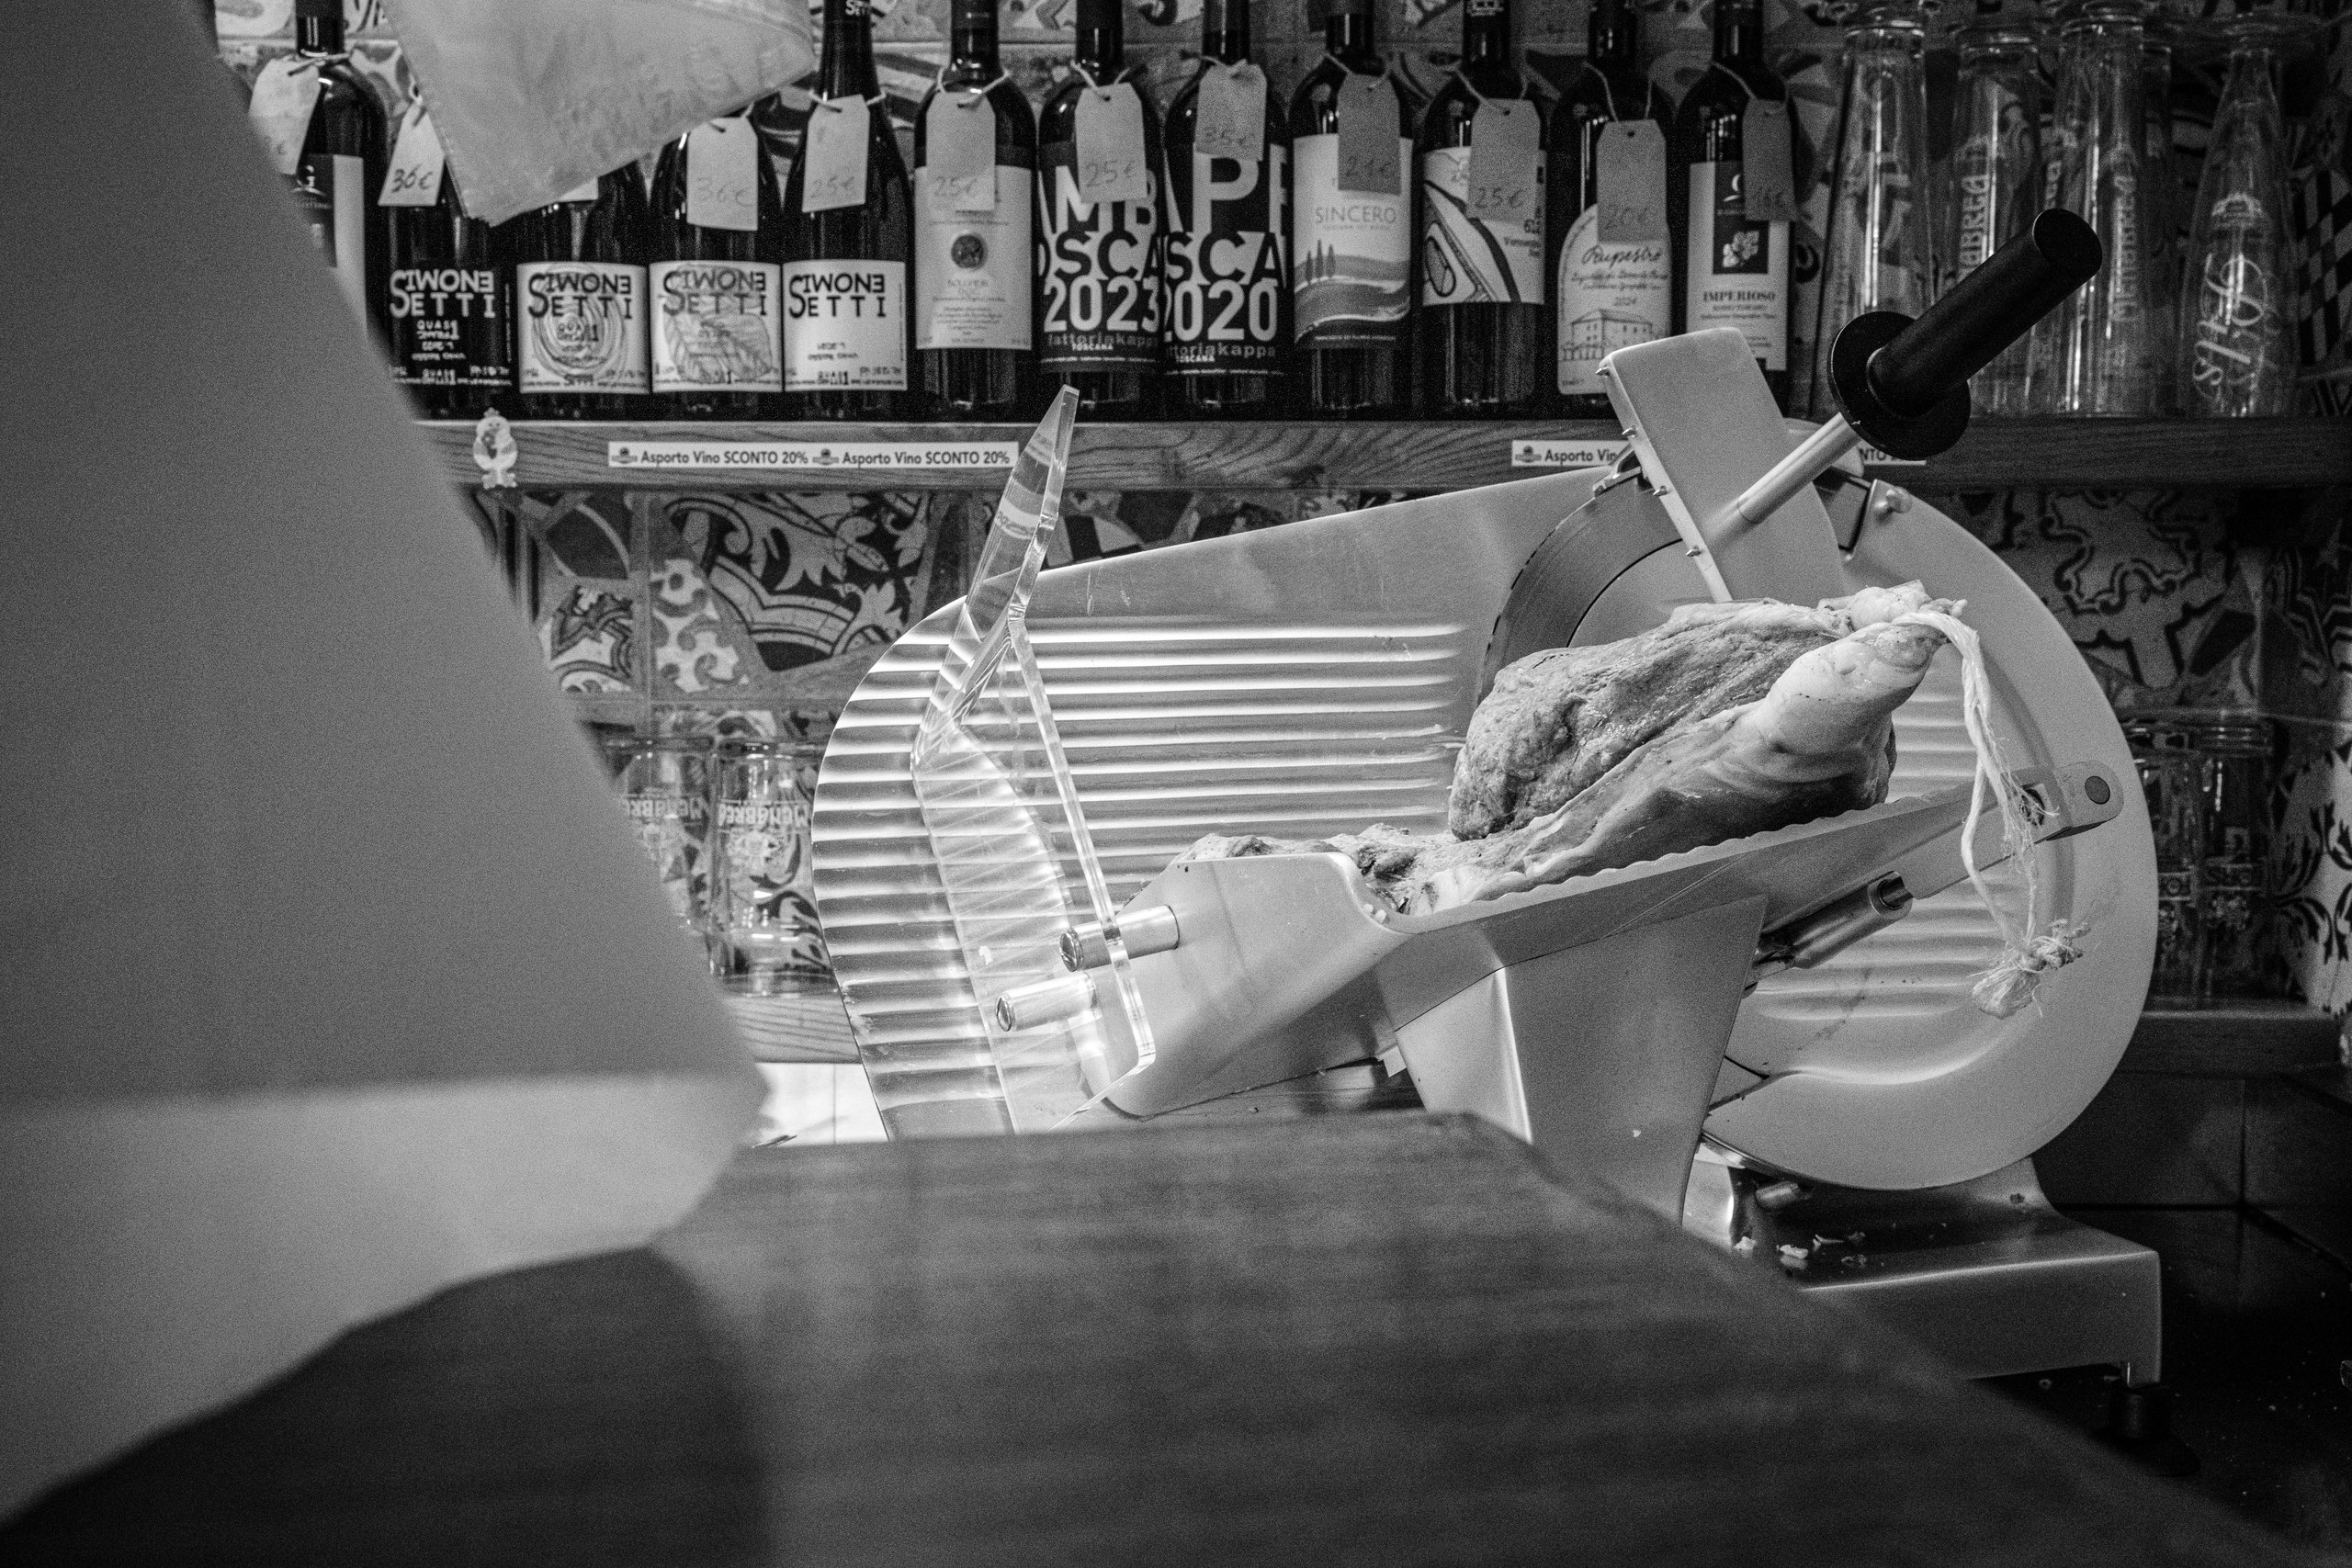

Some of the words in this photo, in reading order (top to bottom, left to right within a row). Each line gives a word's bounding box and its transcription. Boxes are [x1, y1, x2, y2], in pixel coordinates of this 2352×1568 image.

[1315, 205, 1397, 224] SINCERO
[1044, 276, 1159, 333] 2023
[641, 451, 689, 468] Asporto
[693, 451, 720, 463] Vino
[724, 450, 778, 464] SCONTO
[782, 451, 808, 464] 20%
[842, 451, 891, 468] Asporto
[894, 451, 922, 464] Vino
[925, 450, 980, 464] SCONTO
[983, 451, 1011, 464] 20%
[1544, 449, 1594, 466] Asporto
[1597, 449, 1618, 462] Vin
[1859, 448, 1886, 461] NTO
